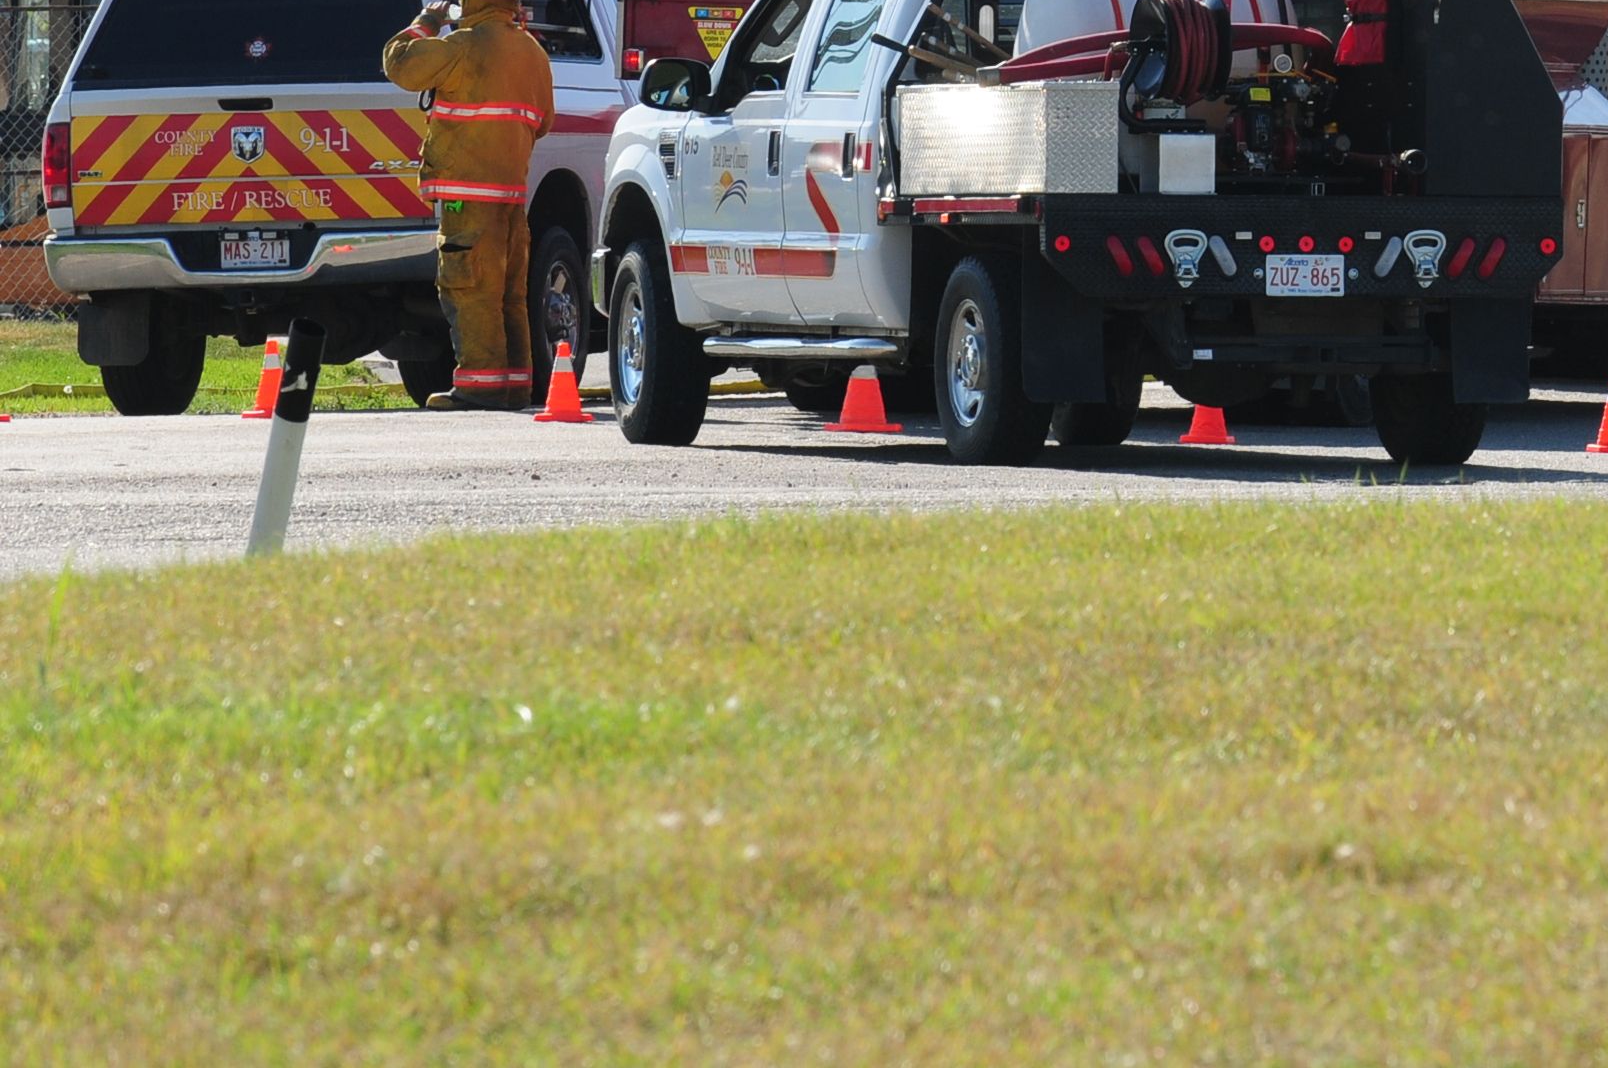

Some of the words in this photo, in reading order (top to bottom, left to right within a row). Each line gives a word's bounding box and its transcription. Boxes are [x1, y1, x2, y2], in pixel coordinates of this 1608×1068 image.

[154, 129, 216, 144] COUNTY
[169, 143, 204, 157] FIRE
[684, 138, 699, 155] 615
[172, 191, 225, 212] FIRE
[230, 191, 239, 211] /
[244, 188, 333, 210] RESCUE
[1269, 266, 1341, 287] ZUZ-865
